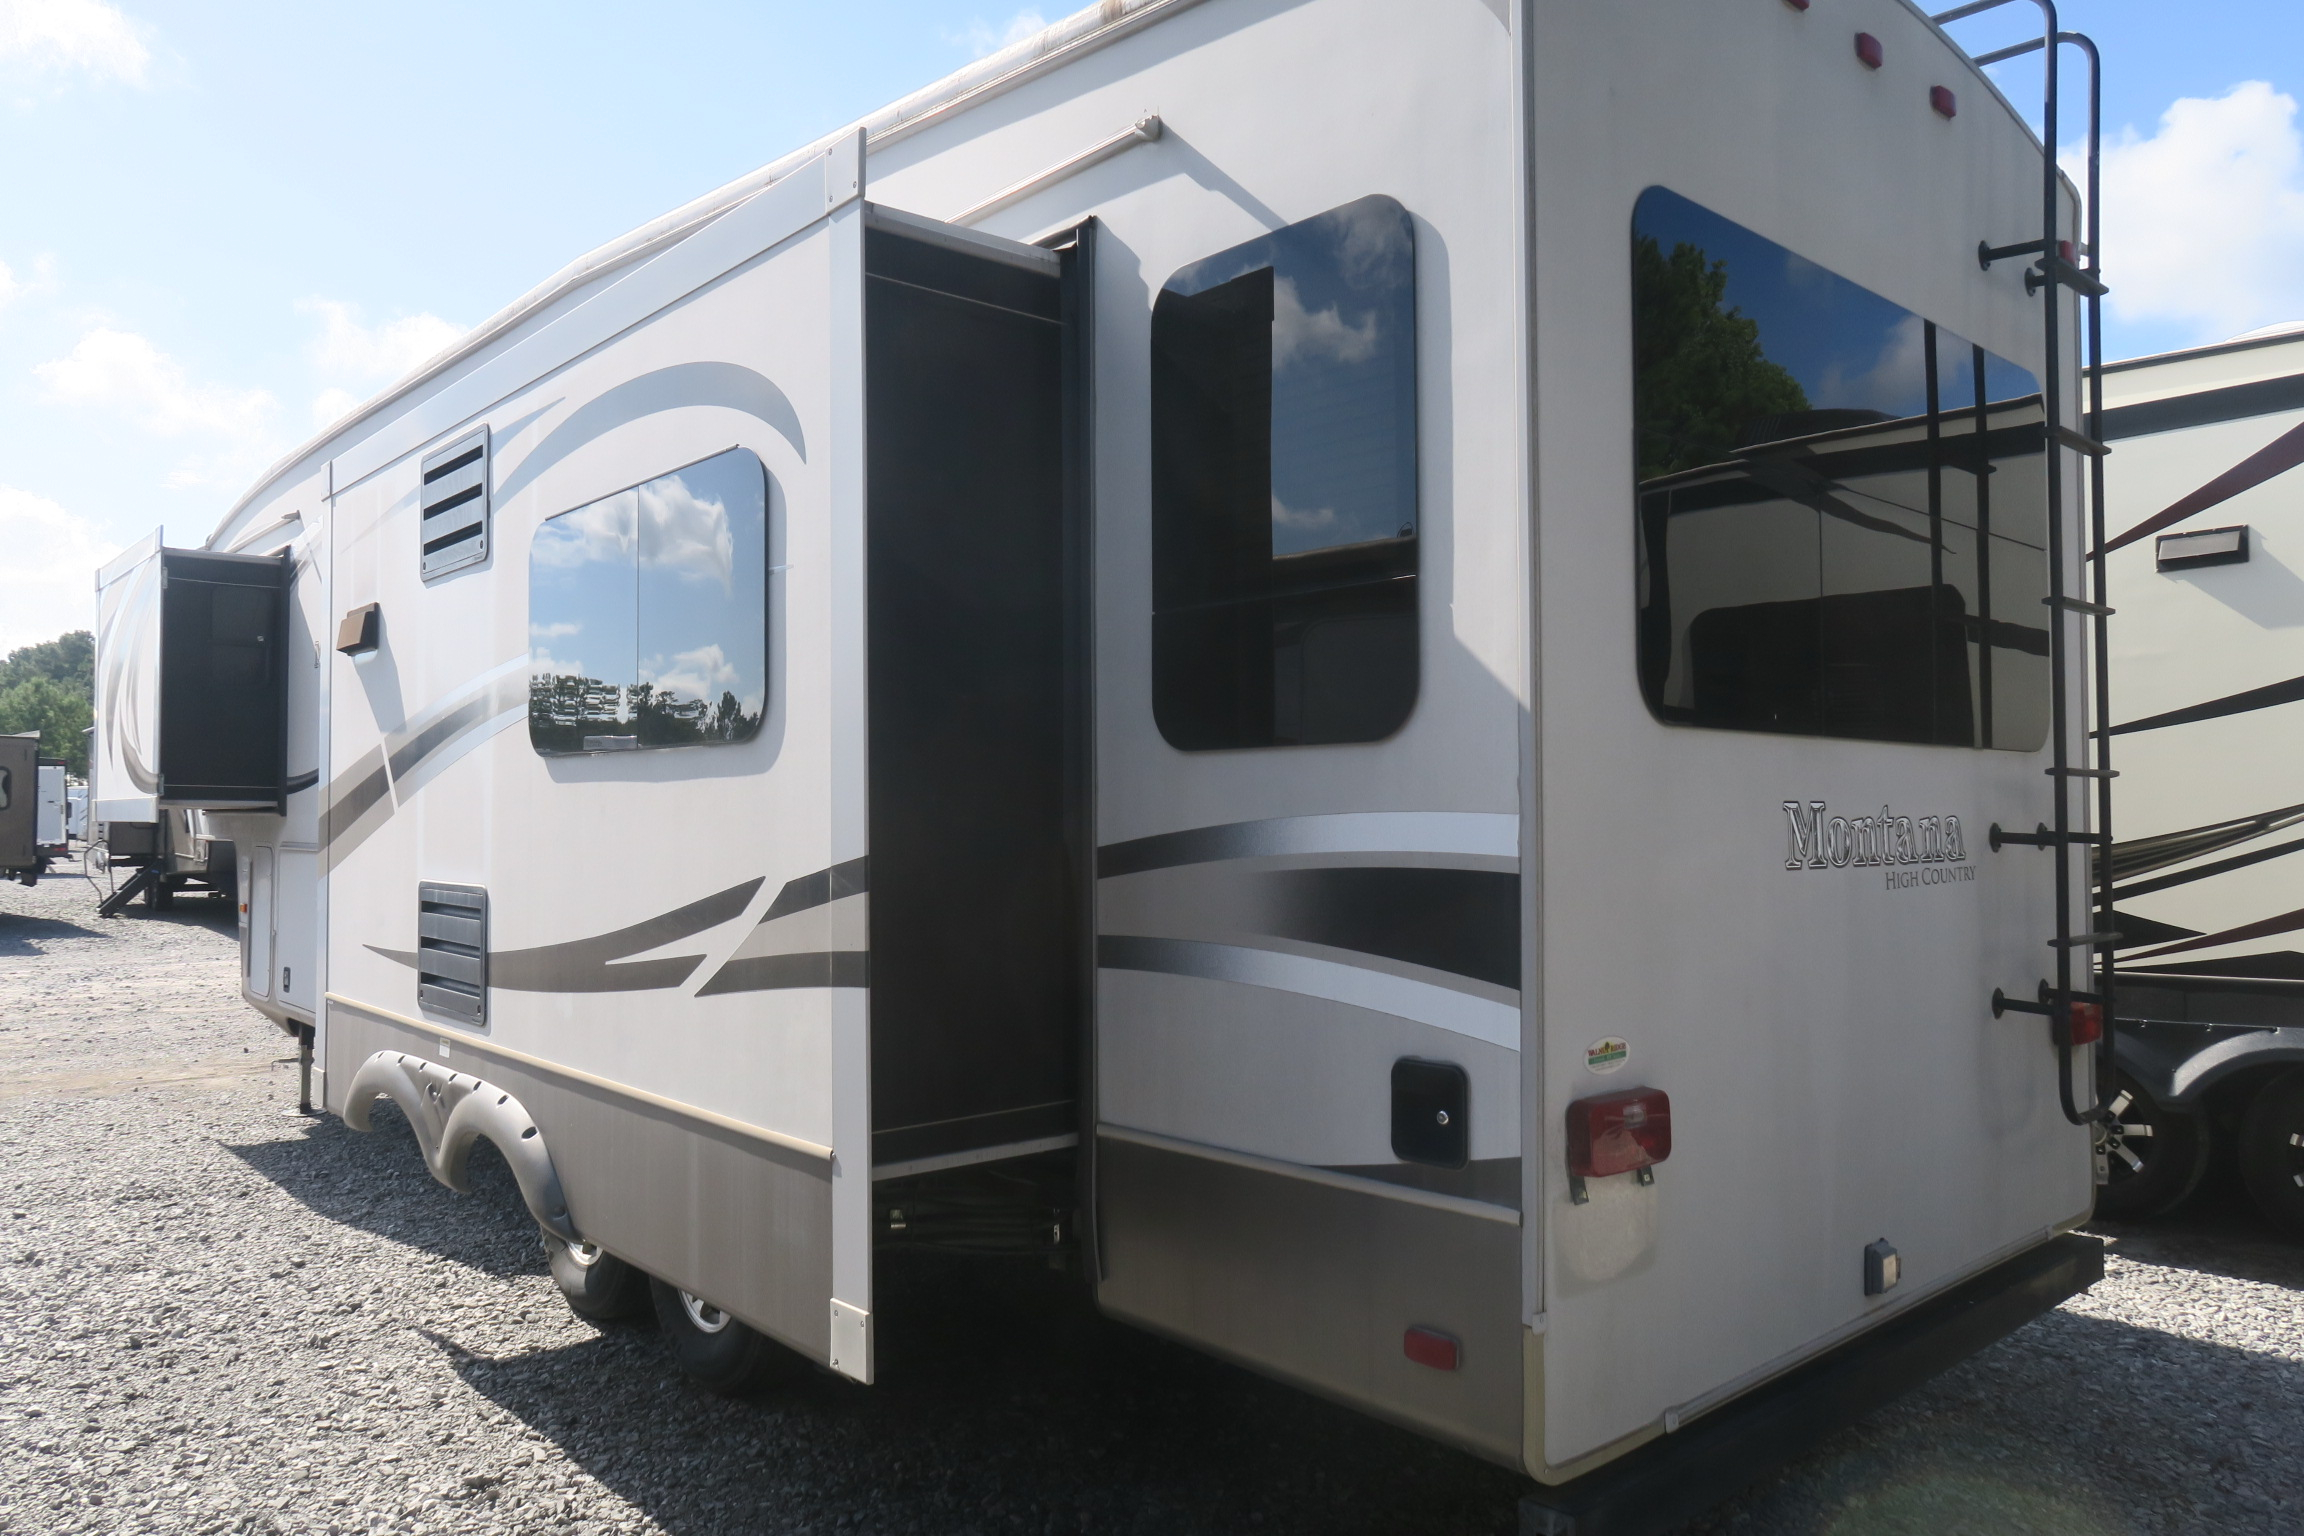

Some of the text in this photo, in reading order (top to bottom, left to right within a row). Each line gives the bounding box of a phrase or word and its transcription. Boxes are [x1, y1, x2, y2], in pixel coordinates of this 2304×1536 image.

[1783, 801, 1966, 870] Montana
[1885, 865, 1977, 890] HIGH COUNTRY
